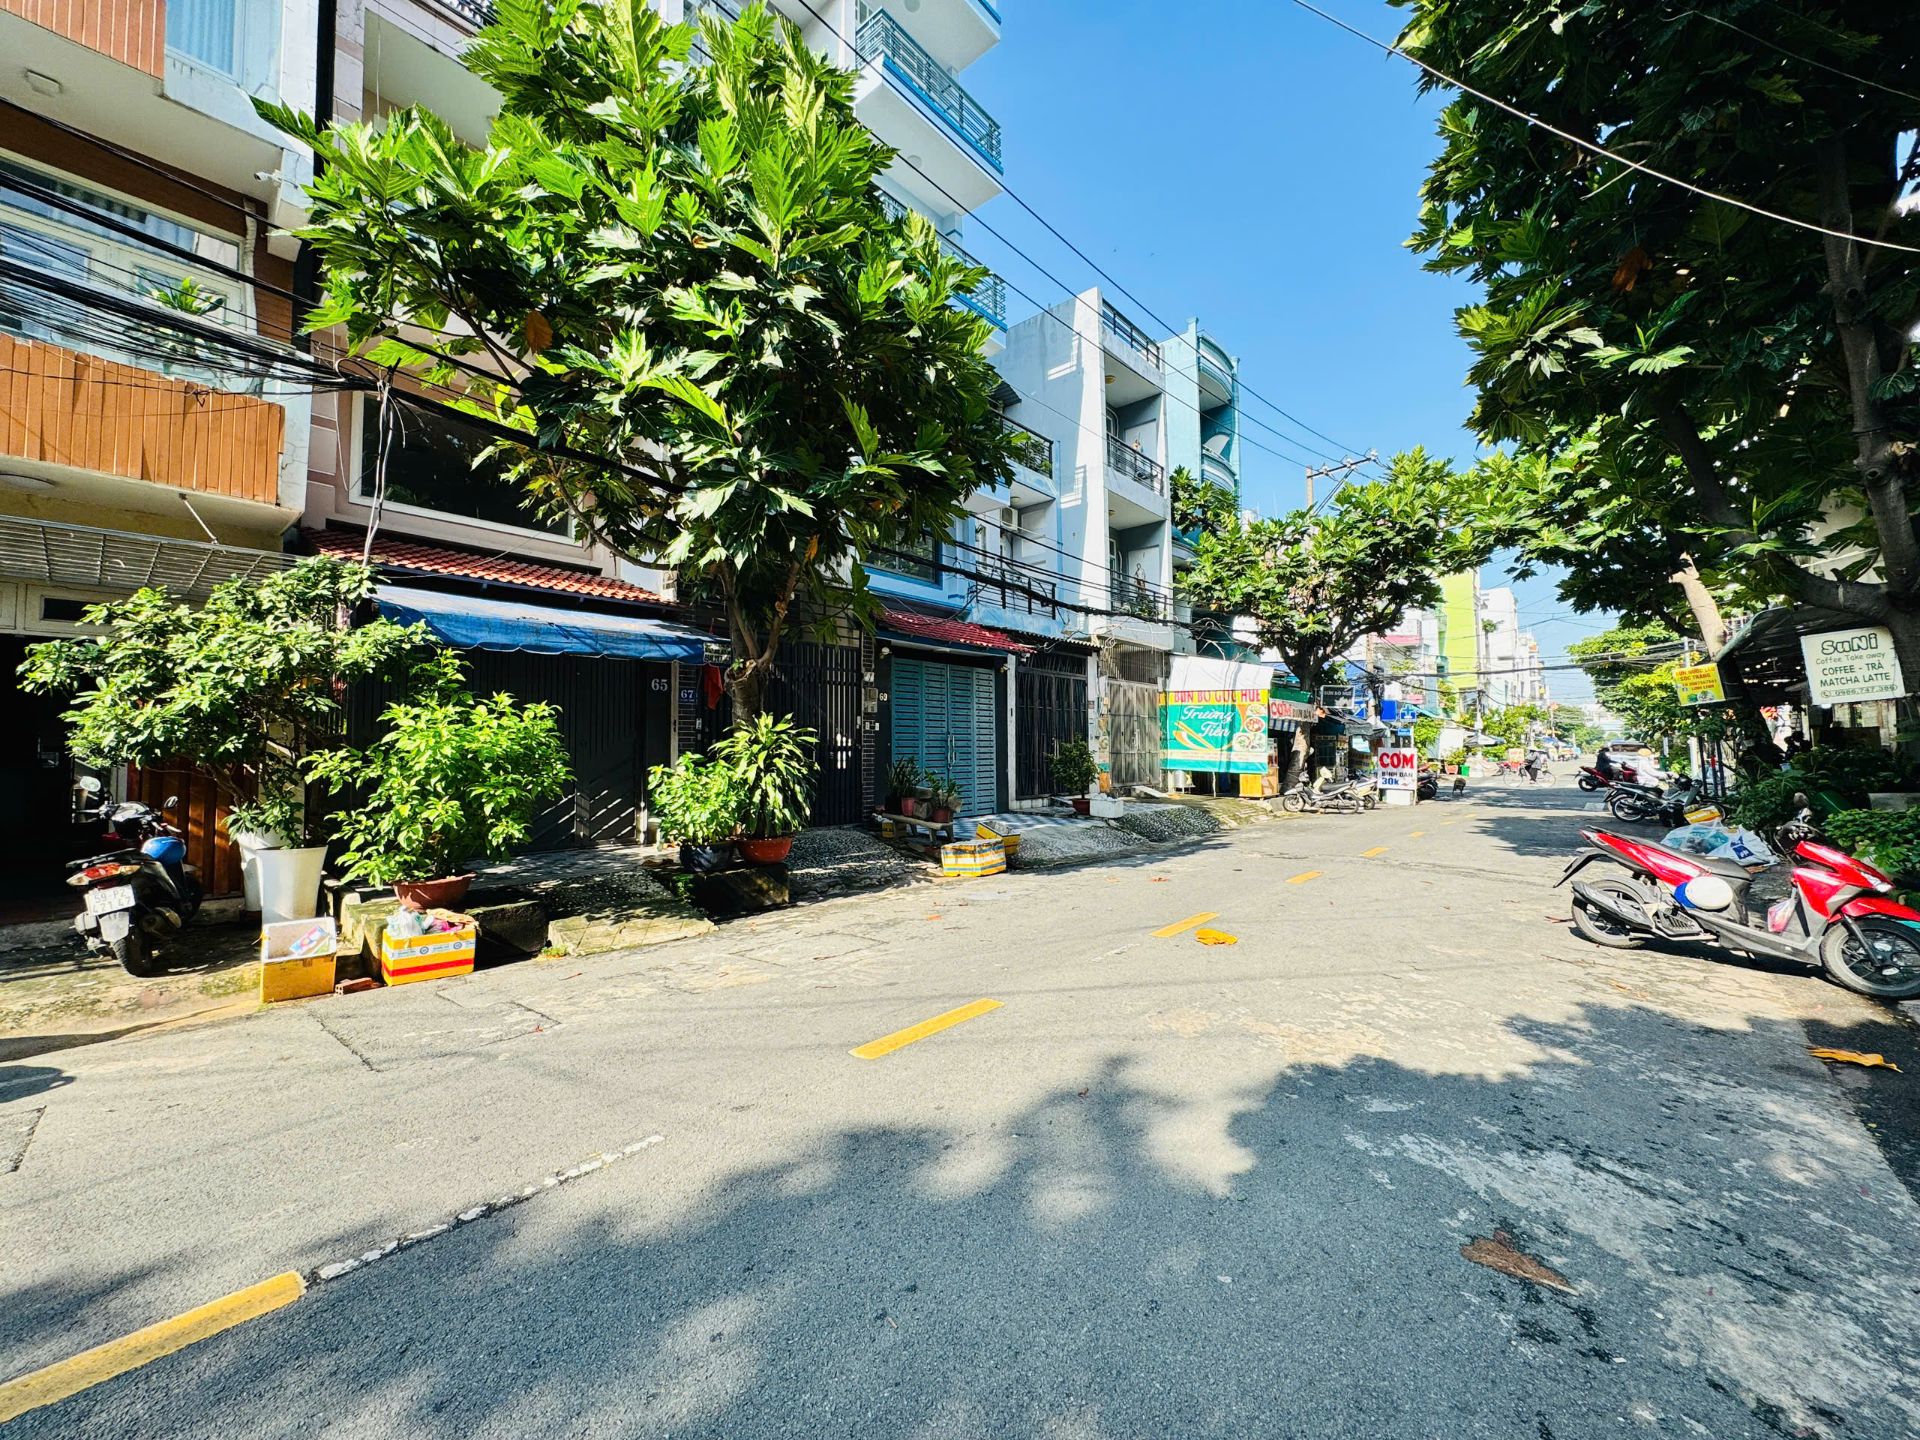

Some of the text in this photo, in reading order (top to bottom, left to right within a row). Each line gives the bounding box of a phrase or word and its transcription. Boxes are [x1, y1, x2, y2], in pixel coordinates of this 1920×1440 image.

[1815, 656, 1843, 665] Coffee
[1844, 653, 1865, 661] Take
[1822, 665, 1856, 676] COFFEE
[651, 679, 668, 692] 65
[1820, 672, 1891, 687] MATCHA LATTE
[680, 690, 694, 699] 67
[1379, 750, 1415, 769] CƠM
[1381, 777, 1400, 785] 30k
